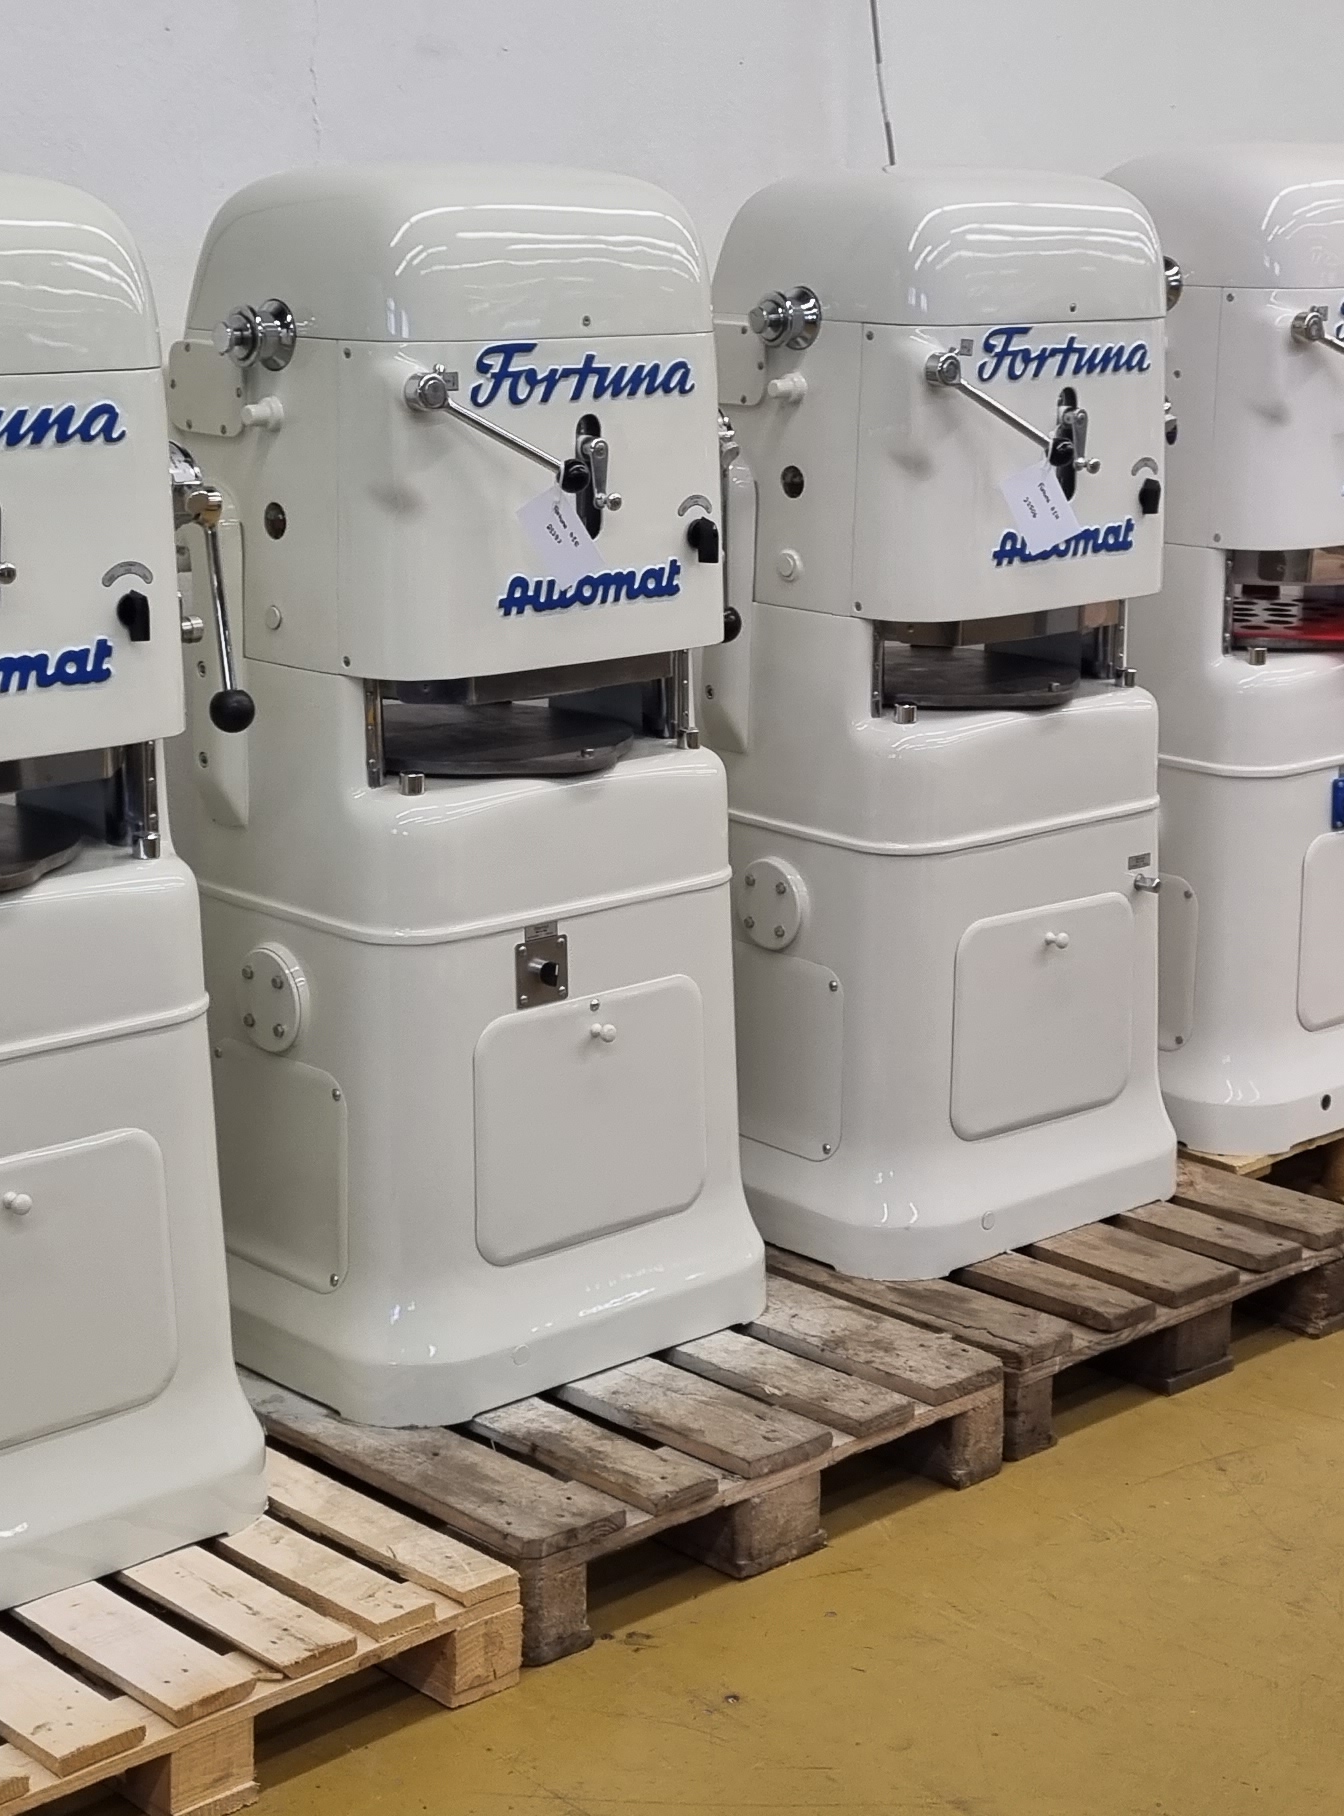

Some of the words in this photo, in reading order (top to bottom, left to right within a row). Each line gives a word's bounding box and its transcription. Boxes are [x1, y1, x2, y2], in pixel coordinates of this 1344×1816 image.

[470, 343, 695, 407] Fortuna
[977, 326, 1151, 382] Fortuna
[992, 517, 1135, 567] Aomat
